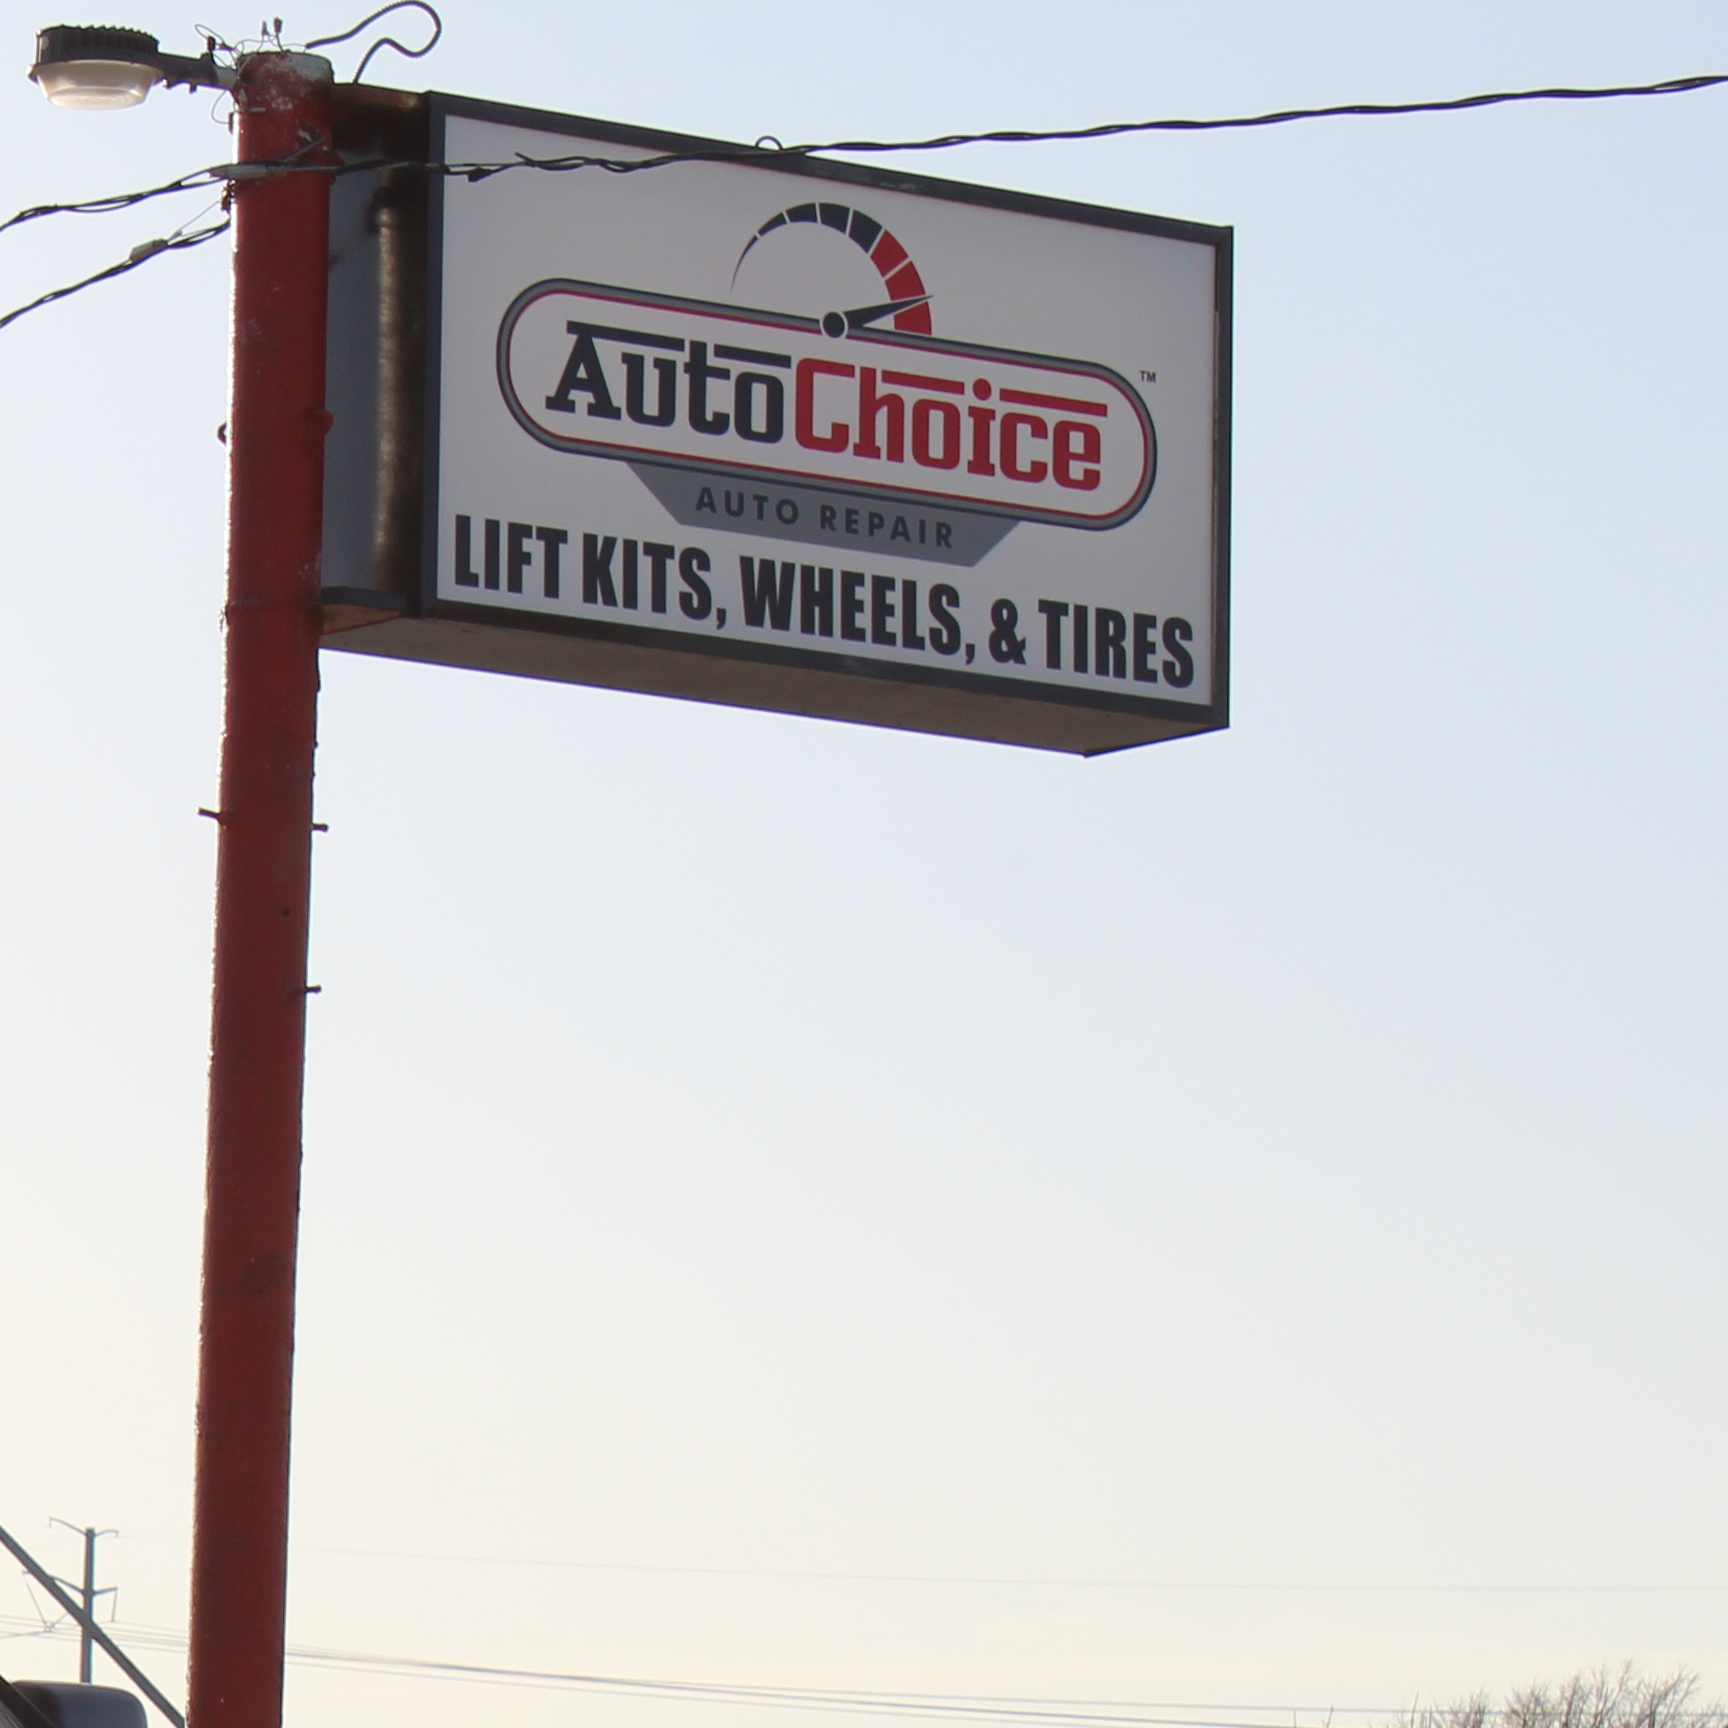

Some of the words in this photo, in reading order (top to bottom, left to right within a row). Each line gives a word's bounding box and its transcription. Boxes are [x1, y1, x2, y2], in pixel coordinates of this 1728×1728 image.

[546, 320, 1108, 491] AutoChoice
[1140, 370, 1156, 383] TM
[695, 486, 799, 525] AUTO
[819, 504, 953, 549] REPAIR
[455, 514, 568, 599] LIFT
[583, 532, 727, 631] KITS,
[739, 555, 976, 665] WHEELS,
[988, 598, 1026, 665] &
[1038, 599, 1194, 688] TIRES
